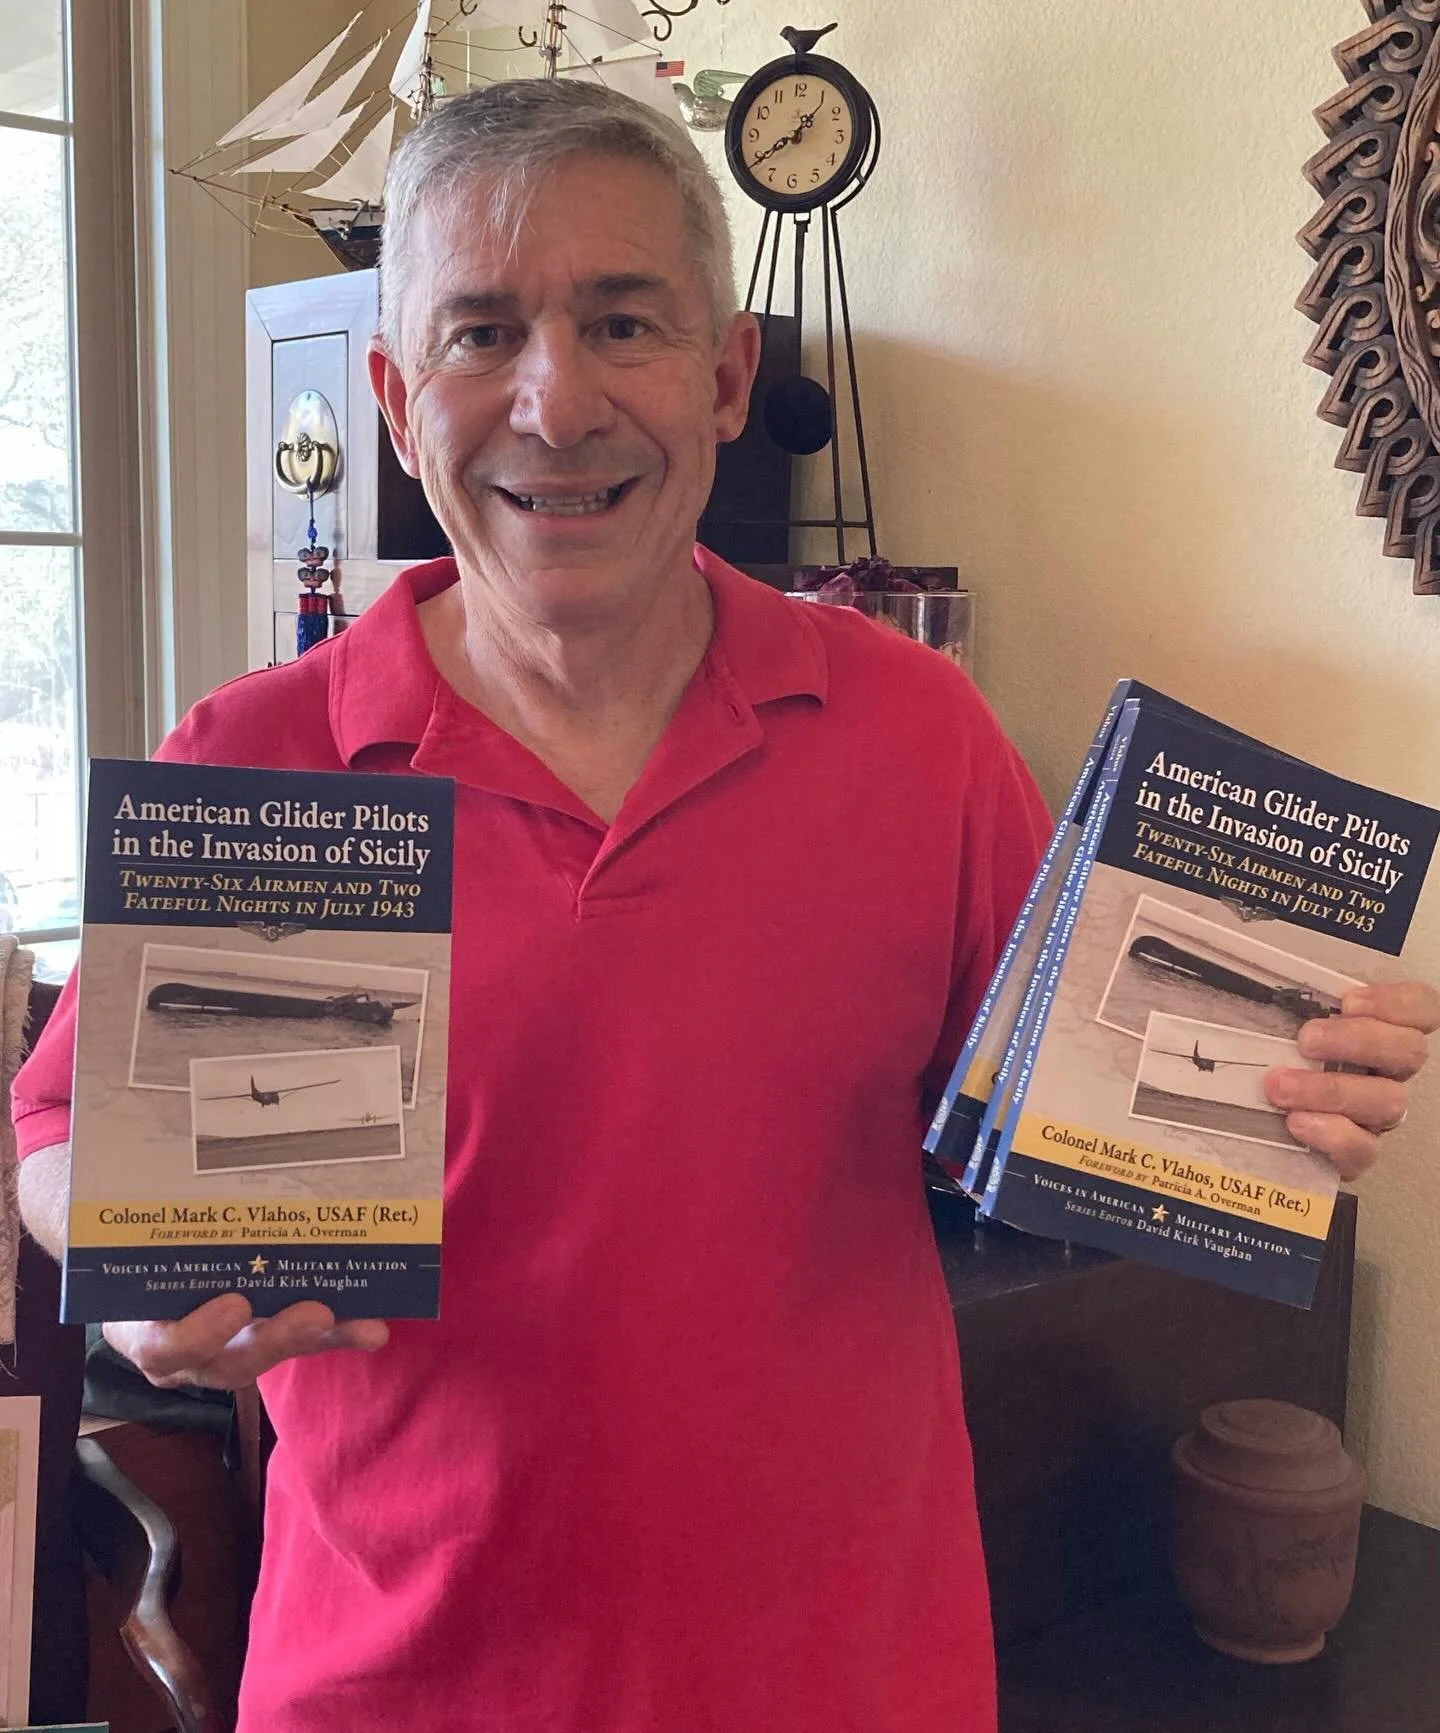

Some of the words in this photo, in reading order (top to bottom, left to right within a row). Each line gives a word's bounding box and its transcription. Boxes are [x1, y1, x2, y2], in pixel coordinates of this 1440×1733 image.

[774, 90, 783, 103] 11
[794, 83, 808, 98] 12
[757, 106, 770, 120] 10
[831, 107, 841, 121] 2
[748, 128, 760, 143] 9
[834, 130, 844, 144] 3
[826, 152, 837, 166] 4
[768, 168, 777, 182] 7
[787, 174, 797, 188] 6
[810, 169, 820, 183] 5
[1065, 757, 1094, 816] American
[113, 794, 252, 826] American
[259, 801, 346, 829] Glider
[352, 804, 429, 833] Pilots
[1144, 751, 1257, 808] American
[1263, 789, 1340, 833] Glider
[1341, 813, 1411, 856] Pilots
[1087, 792, 1110, 855] American
[112, 828, 140, 856] in
[150, 829, 194, 858] the
[201, 833, 317, 863] Invasion
[325, 837, 356, 864] of
[359, 839, 431, 875] Sicily
[1047, 820, 1068, 860] Glider
[1135, 781, 1161, 811] in
[1167, 793, 1204, 824] the
[1206, 805, 1304, 858] Invasion
[1310, 842, 1341, 867] of
[1338, 848, 1404, 895] Sicily
[1074, 859, 1091, 902] Glider
[1136, 821, 1236, 867] TWENTY-SIX
[1236, 856, 1307, 889] AIRMEN
[1307, 882, 1344, 901] AND
[1347, 890, 1386, 914] TWO
[120, 870, 243, 891] TWENTY-SIX
[247, 875, 329, 894] AIRMEN
[331, 882, 372, 895] AND
[379, 879, 421, 897] TWO
[1029, 864, 1050, 899] Pilots
[1132, 843, 1204, 879] FATEFUL
[1207, 866, 1269, 899] NIGHTS
[1271, 890, 1292, 906] IN
[1290, 894, 1333, 919] JULY
[1335, 908, 1375, 933] 1943
[123, 892, 211, 911] FATEFUL
[215, 895, 290, 914] NIGHTS
[295, 900, 317, 915] IN
[319, 898, 366, 920] JULY
[370, 900, 415, 919] 1943
[1023, 903, 1034, 915] in
[1013, 919, 1026, 939] the
[1060, 906, 1078, 944] Pilots
[1055, 948, 1065, 961] in
[990, 943, 1017, 994] Invasion
[1048, 966, 1059, 987] the
[983, 998, 991, 1014] of
[1030, 991, 1052, 1046] Invasion
[967, 1015, 986, 1048] Sicily
[1025, 1050, 1033, 1067] of
[1012, 1068, 1029, 1104] Sicily
[1041, 1125, 1098, 1153] Colonel
[1100, 1141, 1138, 1165] Mark
[1141, 1153, 1156, 1170] C.
[1161, 1158, 1214, 1188] Vlahos,
[1219, 1175, 1266, 1200] USAF
[1268, 1188, 1311, 1217] (Ret.)
[1079, 1154, 1134, 1178] FOREWORD
[1135, 1172, 1148, 1183] BY
[1151, 1175, 1192, 1196] Patricia
[1194, 1188, 1207, 1200] A.
[1211, 1193, 1261, 1216] Overman
[99, 1208, 166, 1225] Colonel
[172, 1206, 217, 1223] Mark
[222, 1207, 242, 1222] C.
[248, 1206, 311, 1224] Vlahos,
[317, 1206, 367, 1222] USAF
[372, 1205, 418, 1226] (Ret.)
[1034, 1173, 1073, 1194] VOICES
[1074, 1187, 1087, 1198] IN
[1089, 1190, 1145, 1215] AMERICAN
[1174, 1213, 1232, 1238] MILITARY
[1234, 1231, 1291, 1256] AVIATION
[150, 1228, 218, 1240] FOREWORD
[221, 1229, 237, 1238] BY
[241, 1226, 288, 1238] Patricia
[292, 1227, 306, 1238] A.
[310, 1227, 367, 1238] Overman
[1064, 1200, 1097, 1217] SERIES
[1098, 1209, 1134, 1228] EDITOR
[1136, 1219, 1170, 1238] David
[1173, 1228, 1200, 1246] Kirk
[1203, 1237, 1253, 1262] Vaughan
[102, 1263, 149, 1275] VOICES
[153, 1264, 168, 1273] IN
[172, 1261, 242, 1273] AMERICAN
[277, 1259, 340, 1271] MILITARY
[346, 1259, 408, 1271] AVIATION
[145, 1279, 185, 1291] SERIES
[189, 1278, 232, 1290] EDITOR
[236, 1275, 274, 1289] David
[279, 1274, 309, 1288] Kirk
[313, 1274, 369, 1291] Vaughan
